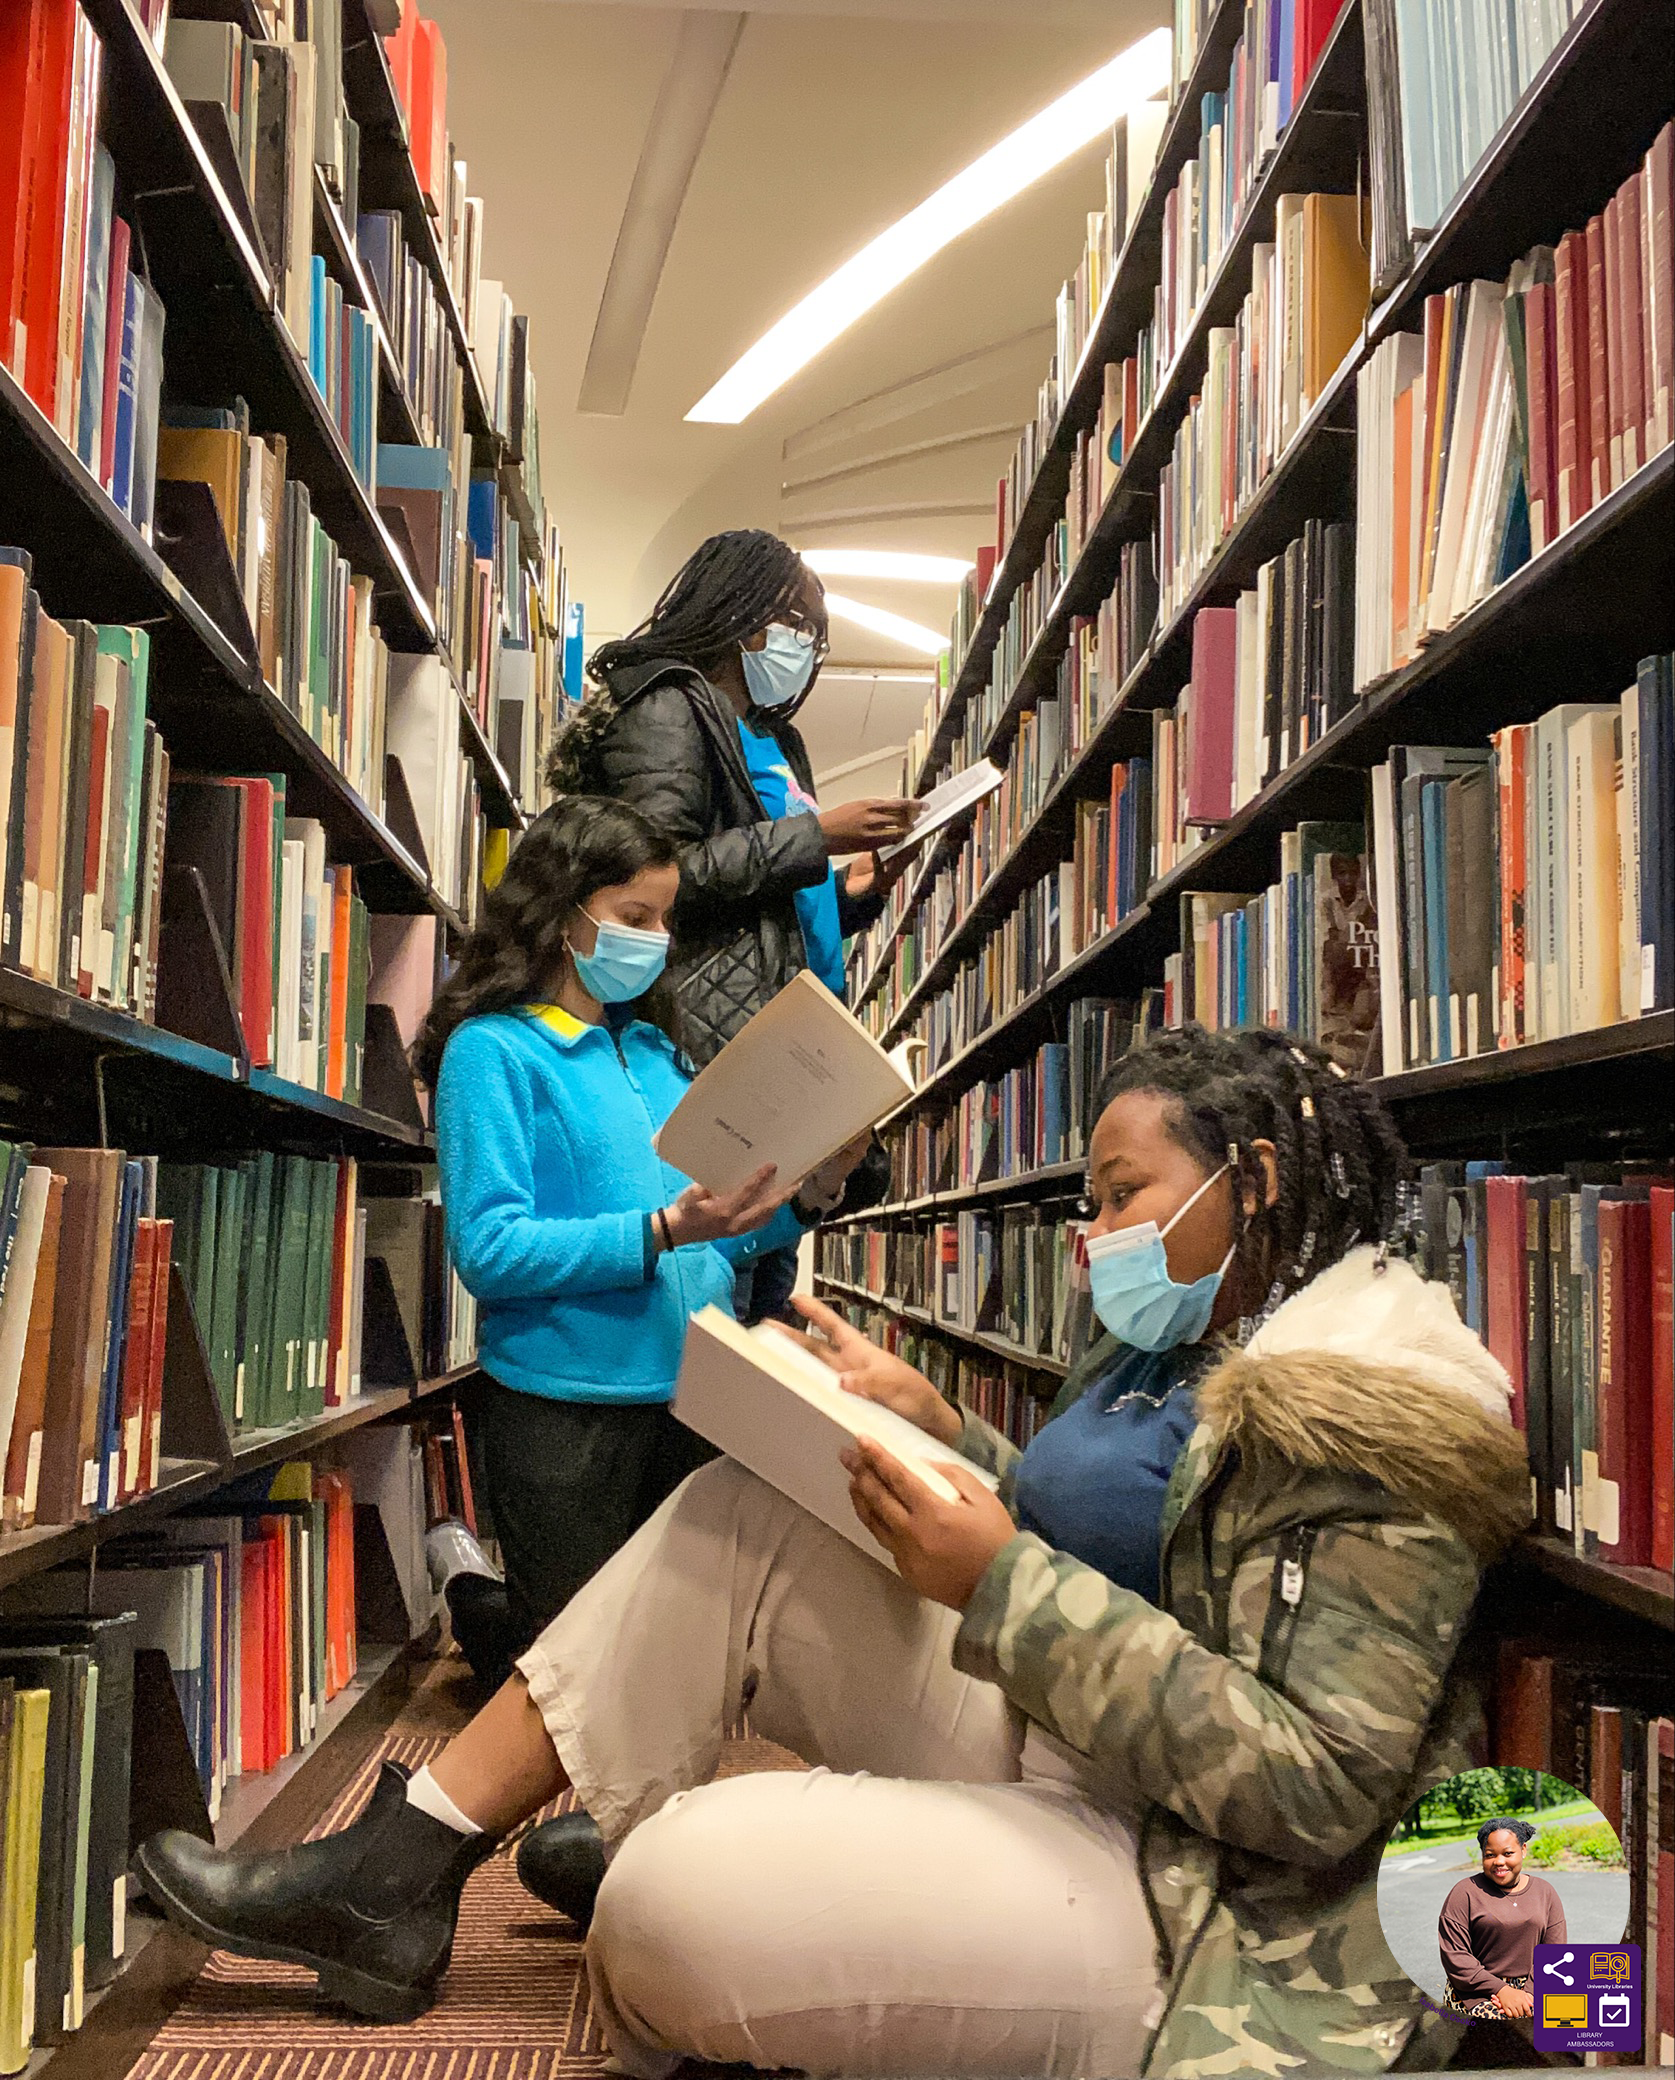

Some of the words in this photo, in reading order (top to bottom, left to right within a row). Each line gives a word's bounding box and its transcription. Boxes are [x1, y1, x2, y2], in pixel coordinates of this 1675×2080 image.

[1630, 730, 1638, 763] Bank
[1631, 767, 1640, 828] Structure
[1632, 832, 1640, 856] and
[1632, 860, 1641, 943] Competition
[1600, 1246, 1613, 1385] GUARANTEE
